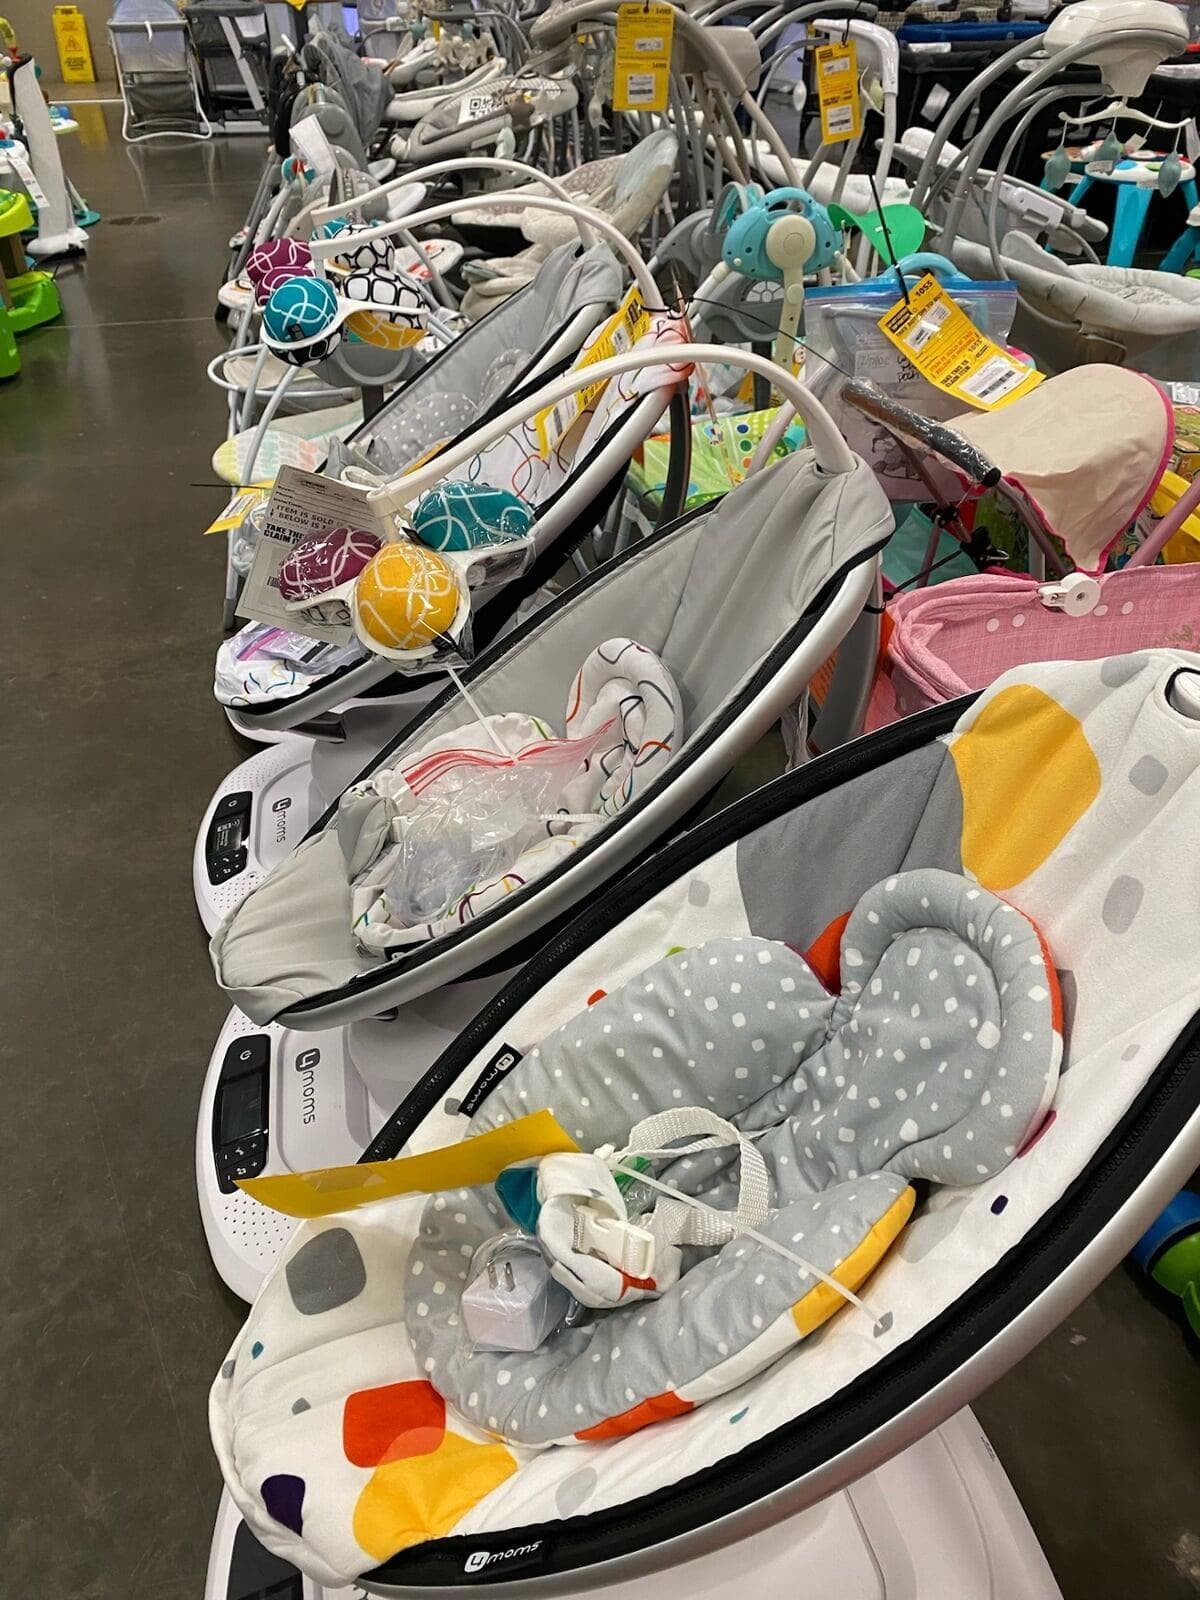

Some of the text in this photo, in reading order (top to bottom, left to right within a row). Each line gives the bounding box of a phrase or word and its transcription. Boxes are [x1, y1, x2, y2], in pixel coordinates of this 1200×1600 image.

[916, 280, 933, 296] 1055
[968, 339, 982, 352] 1055
[276, 504, 298, 516] ITEM
[300, 509, 308, 518] IS
[311, 513, 334, 526] SOLD
[278, 512, 309, 526] BELOW
[311, 521, 319, 529] IS
[263, 529, 291, 543] CLAIM
[265, 522, 304, 540] TAKE THI
[271, 796, 292, 844] 4moms
[295, 1048, 321, 1125] 4moms
[466, 1053, 515, 1112] 4moms
[464, 1540, 543, 1573] 4moms
